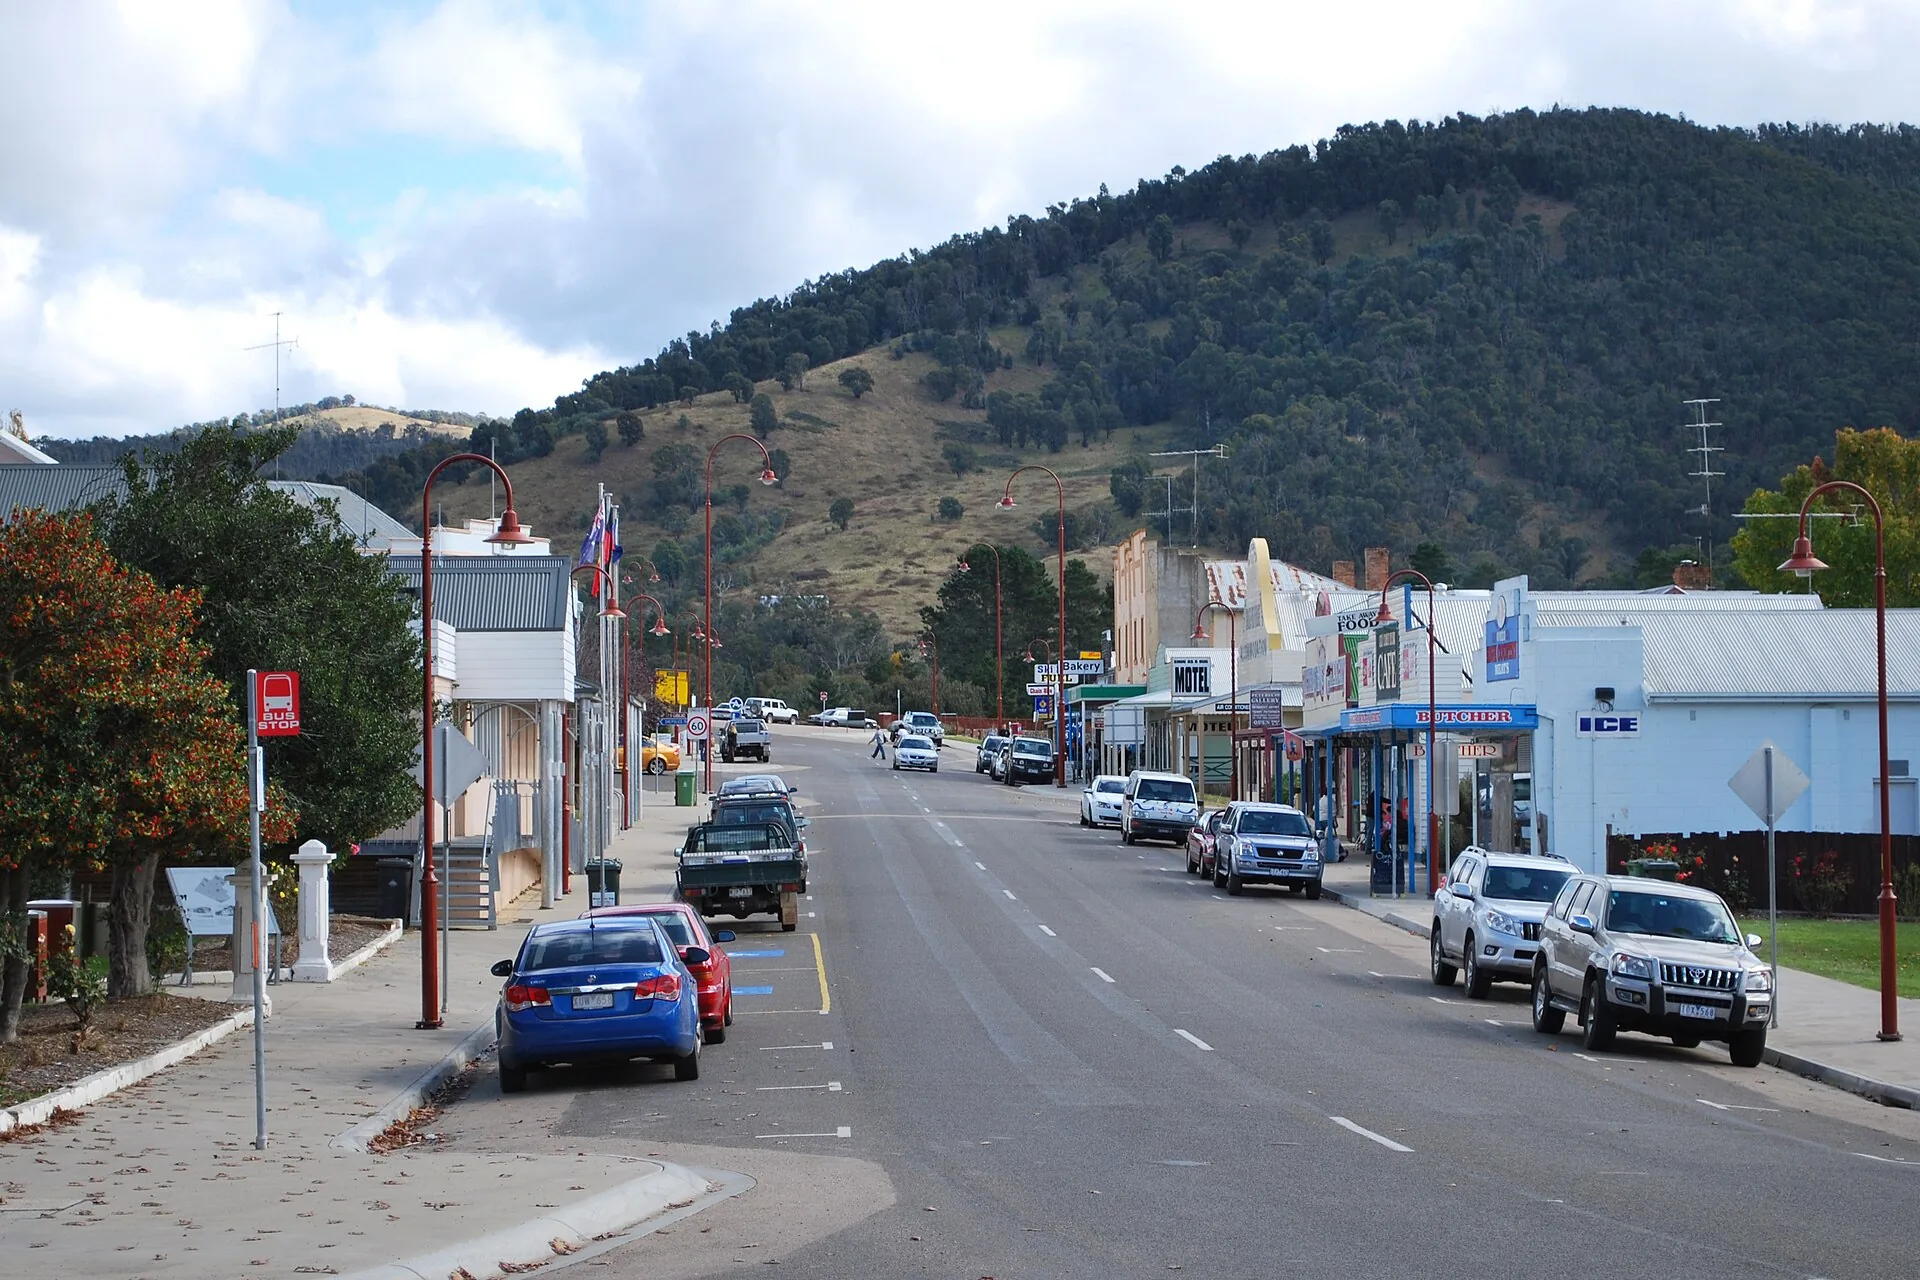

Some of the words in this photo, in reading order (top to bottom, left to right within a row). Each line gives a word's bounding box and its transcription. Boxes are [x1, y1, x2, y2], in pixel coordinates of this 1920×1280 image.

[1359, 610, 1377, 619] AWAY
[1337, 618, 1379, 631] FOOD
[1063, 662, 1100, 672] Bakery
[1377, 651, 1396, 690] CAFE
[1041, 674, 1073, 682] FUL
[1175, 667, 1209, 692] MOTEL
[263, 712, 295, 720] BUS
[1417, 710, 1511, 723] BUTCHER
[258, 721, 299, 729] STOP
[691, 722, 704, 731] 60
[1580, 717, 1638, 732] ICE
